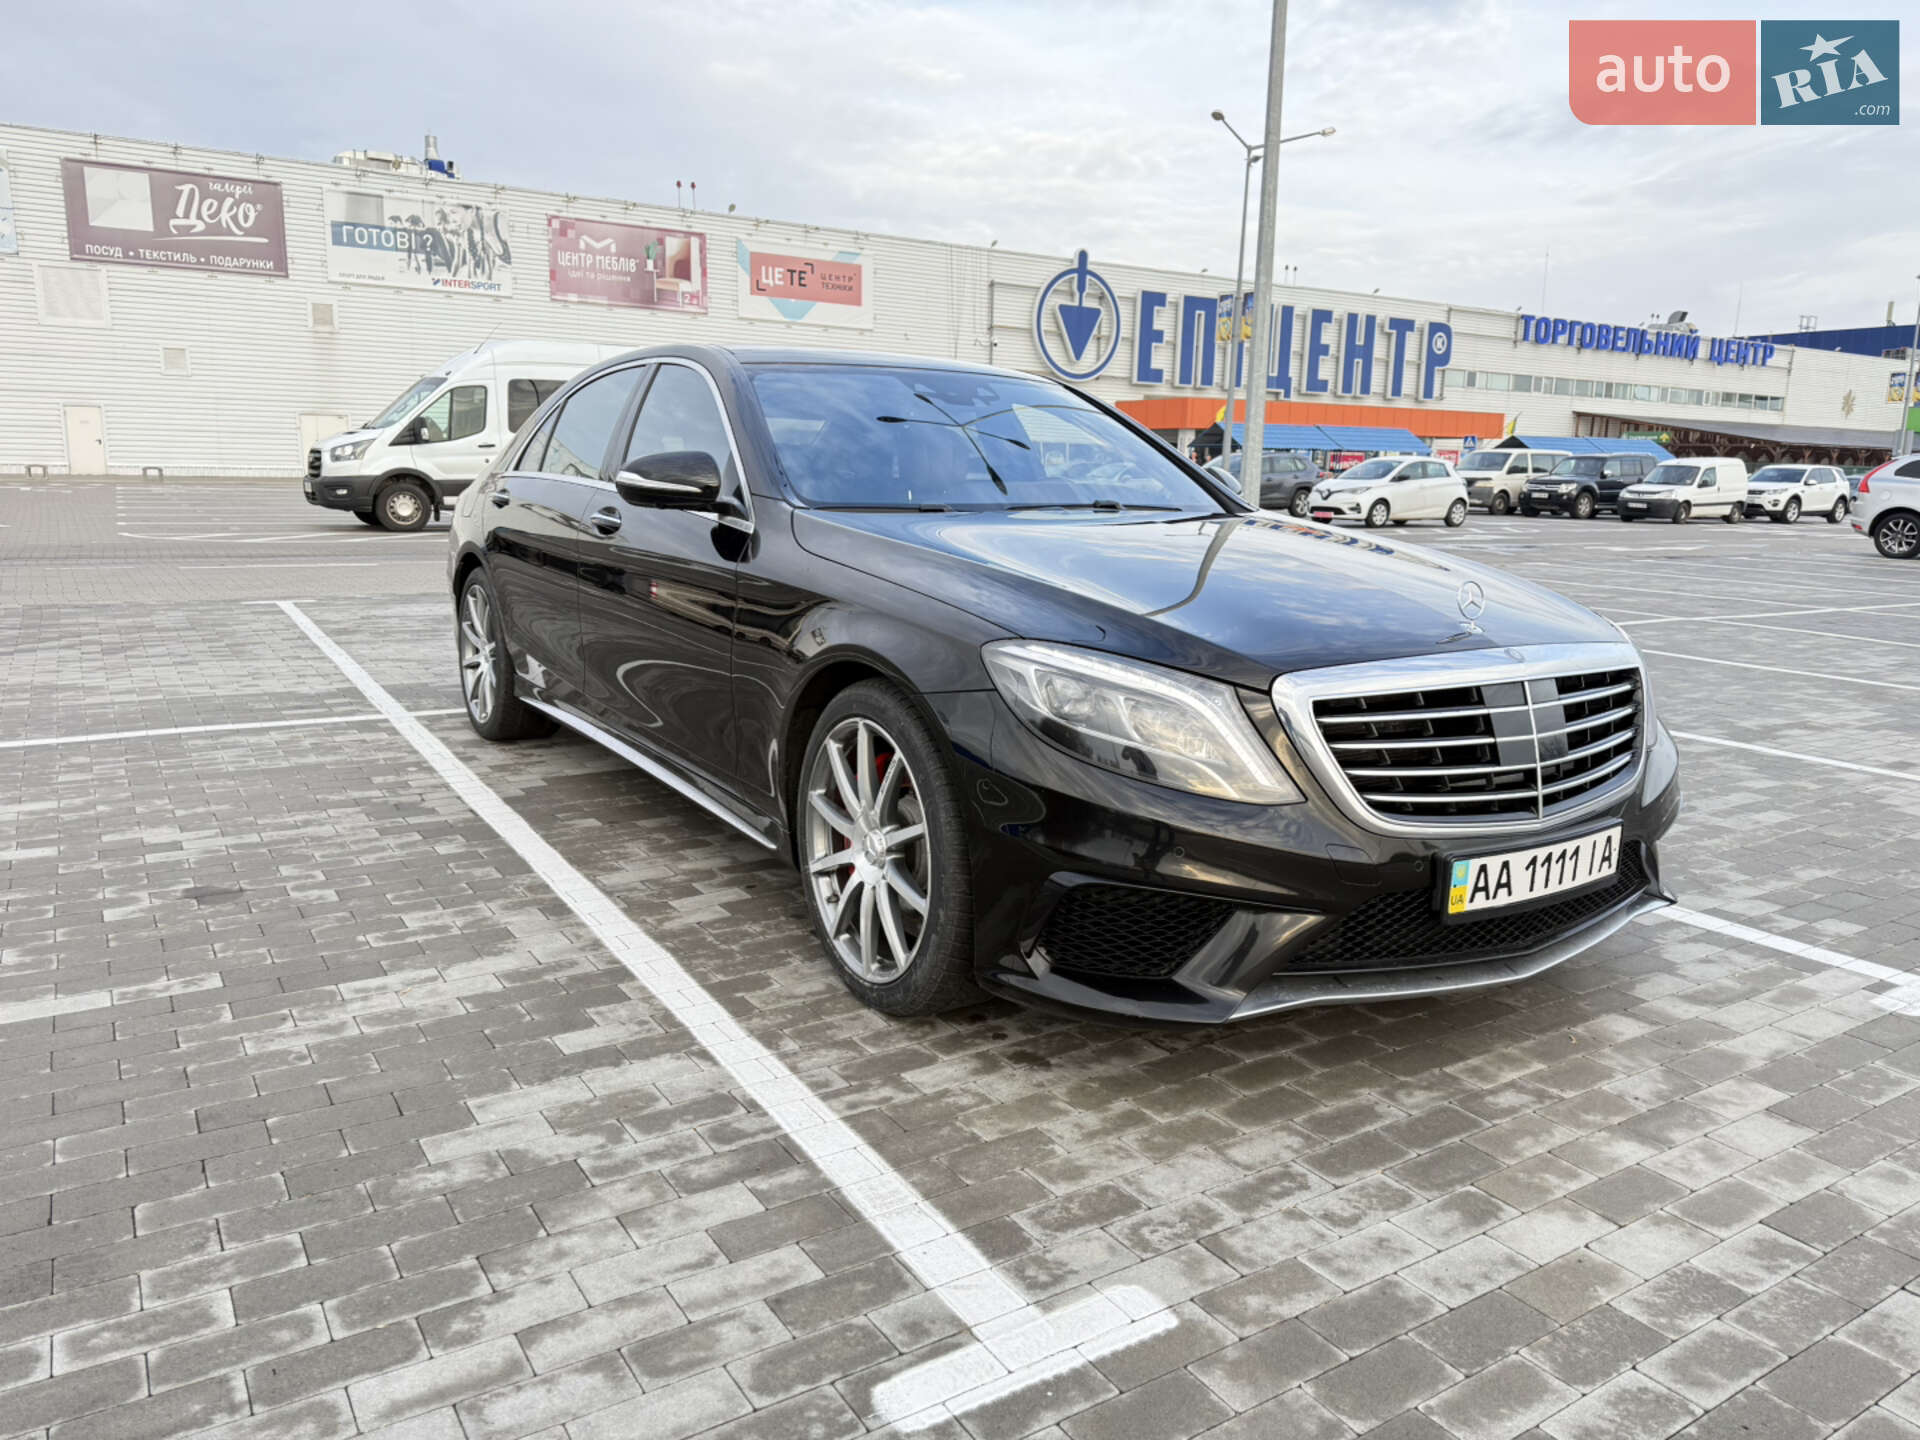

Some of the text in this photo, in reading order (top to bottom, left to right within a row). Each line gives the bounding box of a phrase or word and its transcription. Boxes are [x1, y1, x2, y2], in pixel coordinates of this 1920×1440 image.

[169, 183, 258, 235] Деко
[342, 226, 416, 249] ГОТОВІ
[85, 244, 274, 270] ПОСУД ТЕКСТИЛЬ ПОДАРУНКИ
[557, 250, 637, 272] ЦЕНТР МЕБЛІВ
[441, 279, 502, 291] INTERSPORT
[820, 272, 854, 283] ЦЕНТР
[1520, 314, 1776, 366] ТОРГОВЕЛЬНИЙ ЦЕНТР
[1469, 835, 1612, 903] AA 1111 IA
[1450, 895, 1464, 905] UA
